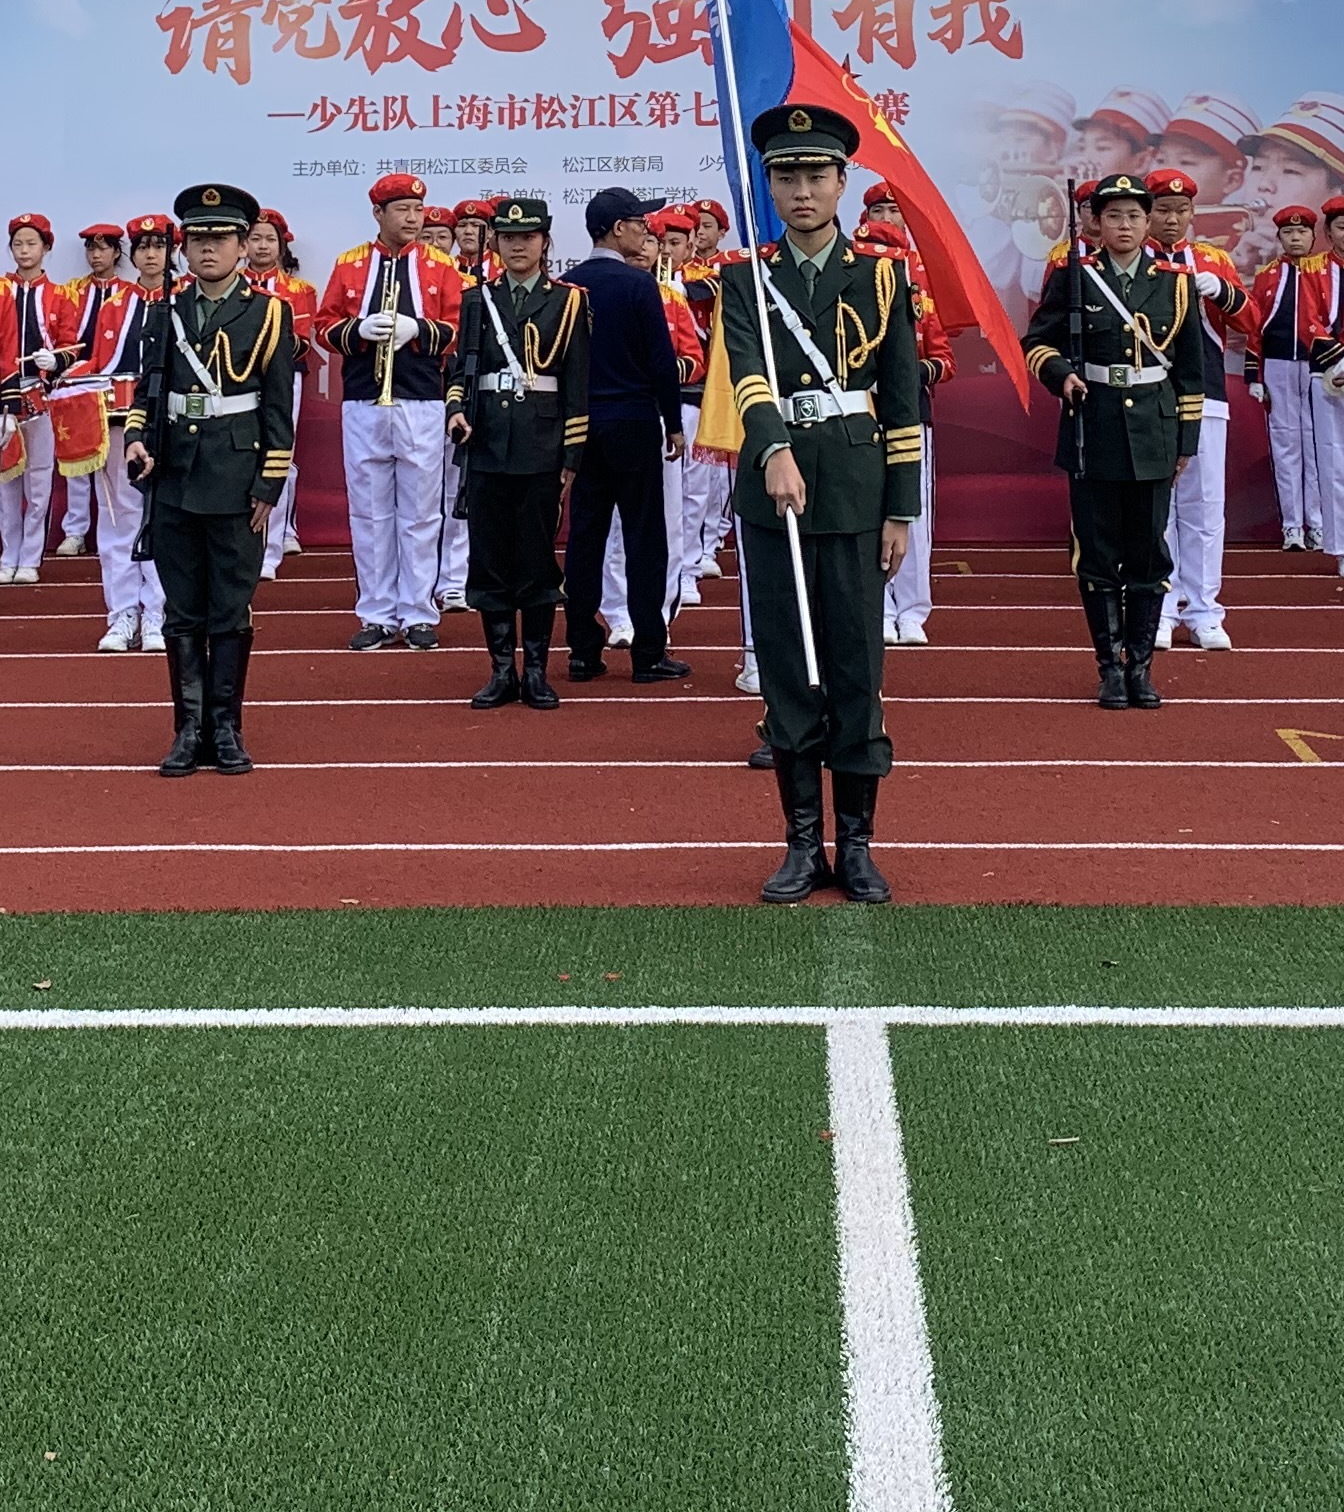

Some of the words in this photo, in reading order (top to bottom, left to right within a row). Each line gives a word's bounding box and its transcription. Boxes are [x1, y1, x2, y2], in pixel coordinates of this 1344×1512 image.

[562, 155, 664, 173] 松江区教育局
